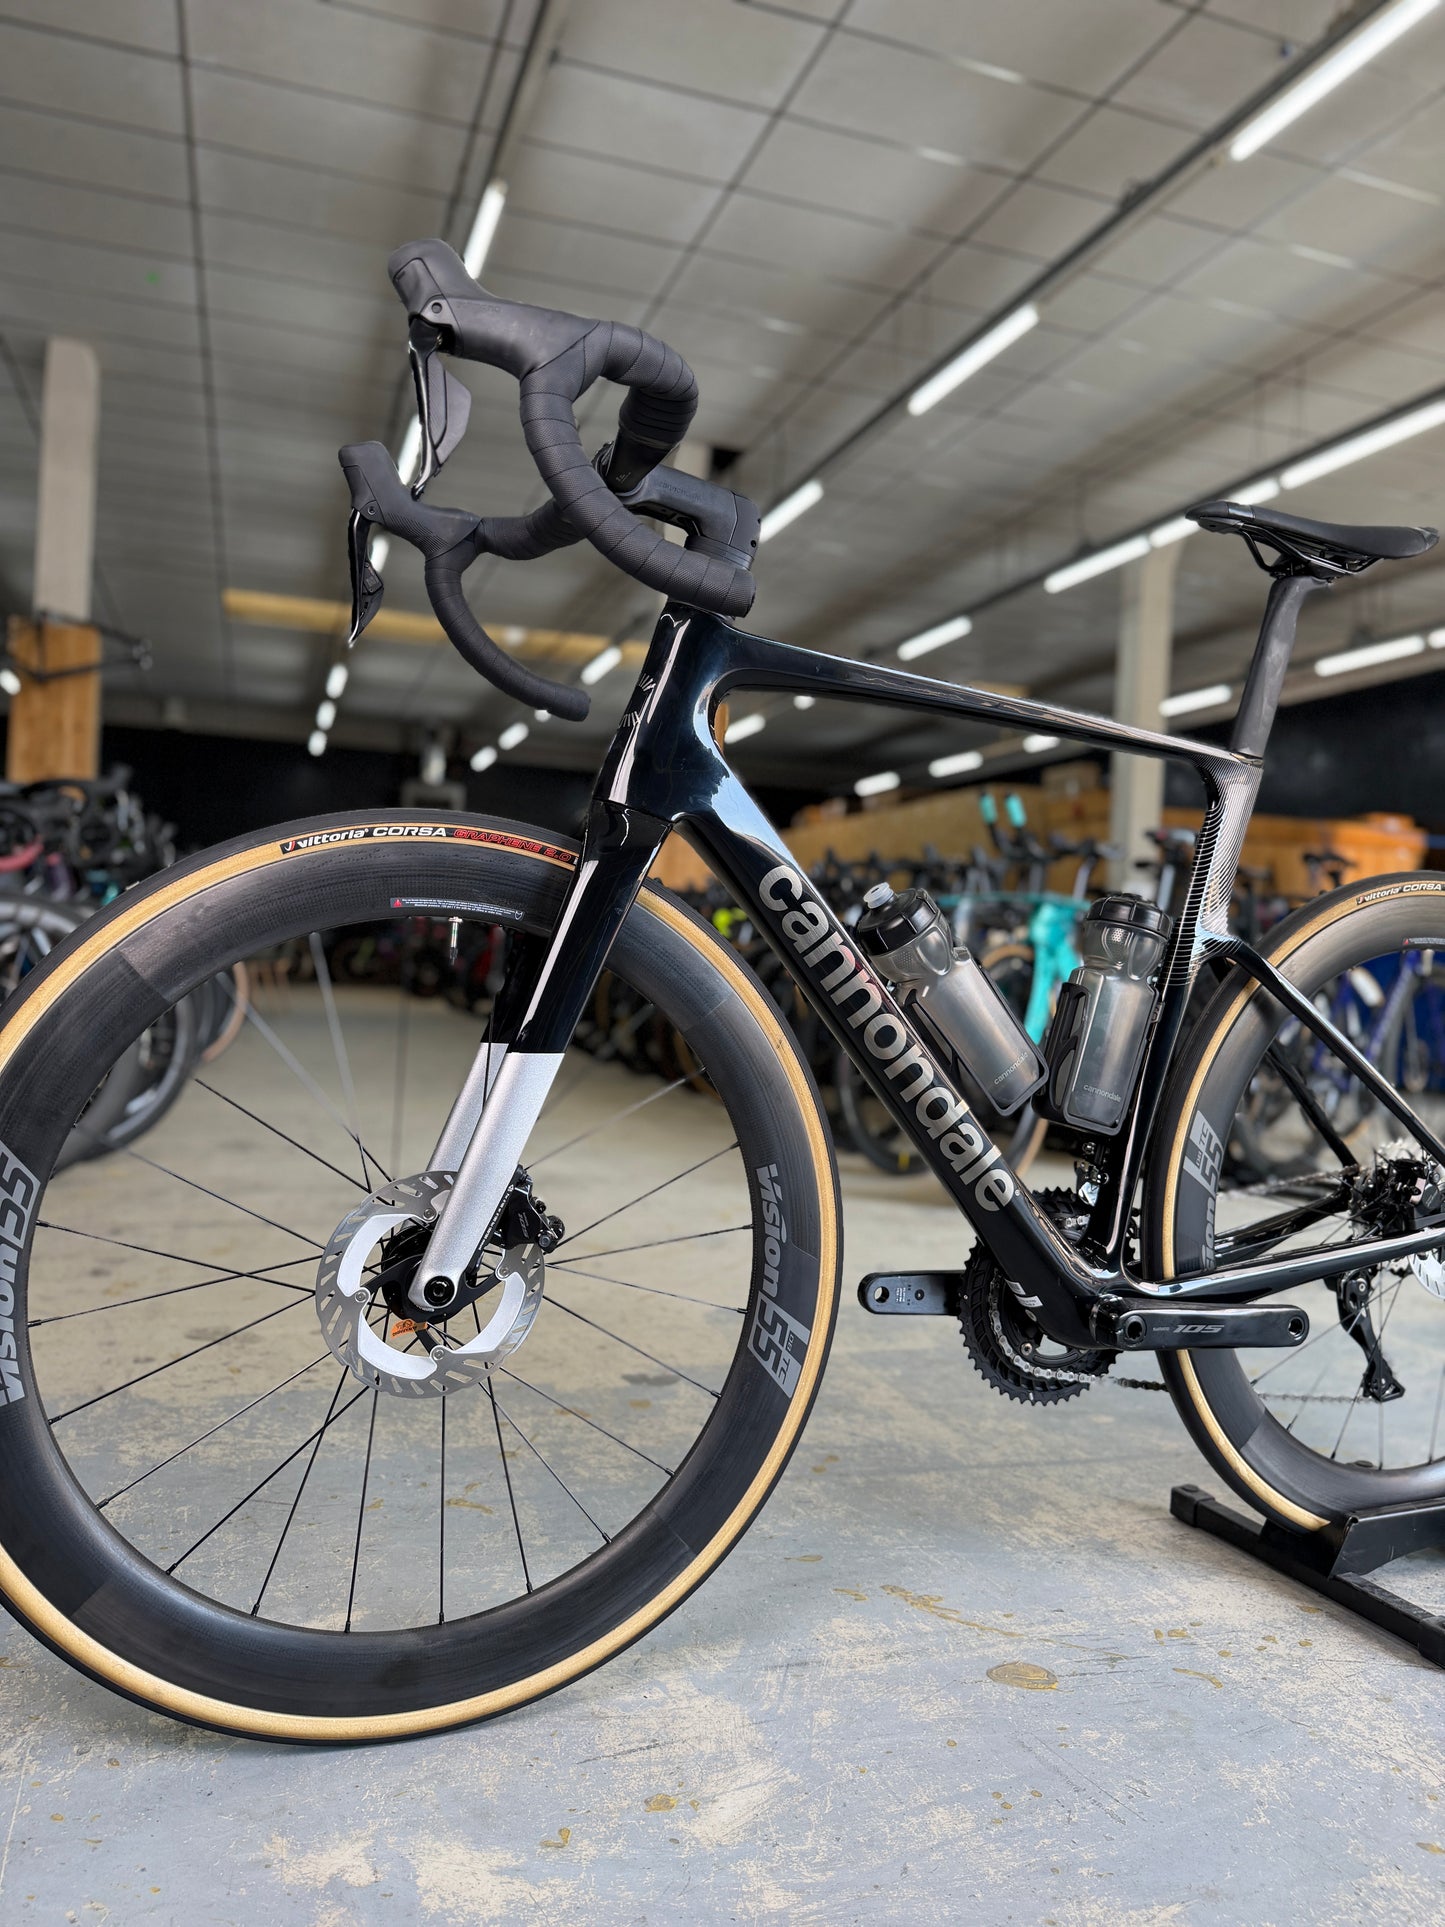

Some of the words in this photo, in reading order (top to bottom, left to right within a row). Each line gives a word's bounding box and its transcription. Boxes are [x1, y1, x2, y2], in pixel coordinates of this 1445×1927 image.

[373, 826, 447, 838] CORSA
[453, 828, 543, 852] GRAPHENE
[543, 848, 571, 862] 2.0
[1403, 883, 1442, 892] CORSA
[758, 865, 1015, 1212] cannondale
[994, 1051, 1028, 1085] cannondale
[1083, 1084, 1121, 1102] cannondale
[1201, 1133, 1222, 1193] 55
[753, 1298, 789, 1374] 55
[1173, 1324, 1225, 1334] 105
[778, 1357, 791, 1385] TC
